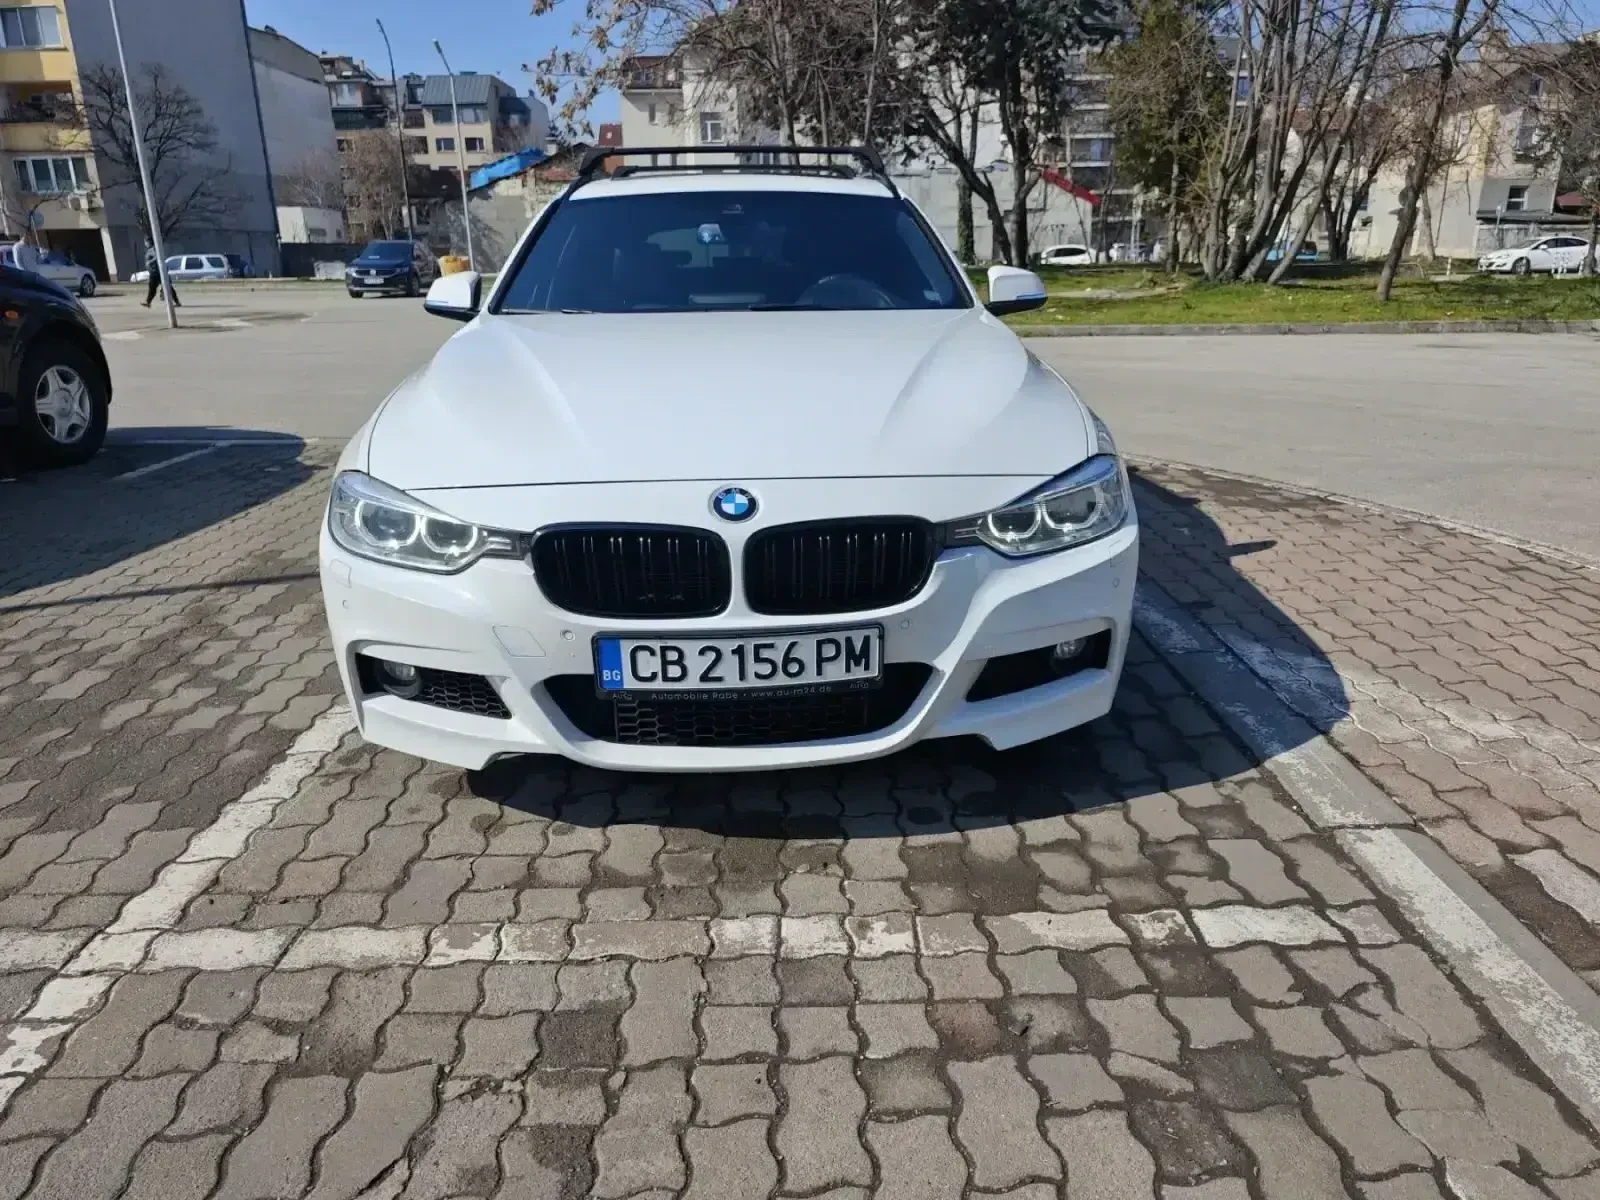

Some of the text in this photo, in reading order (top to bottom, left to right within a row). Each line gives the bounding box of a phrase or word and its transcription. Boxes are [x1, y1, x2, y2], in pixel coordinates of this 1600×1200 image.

[629, 635, 872, 683] CB 2156 PM
[603, 670, 621, 681] BG
[651, 692, 709, 701] Automobile
